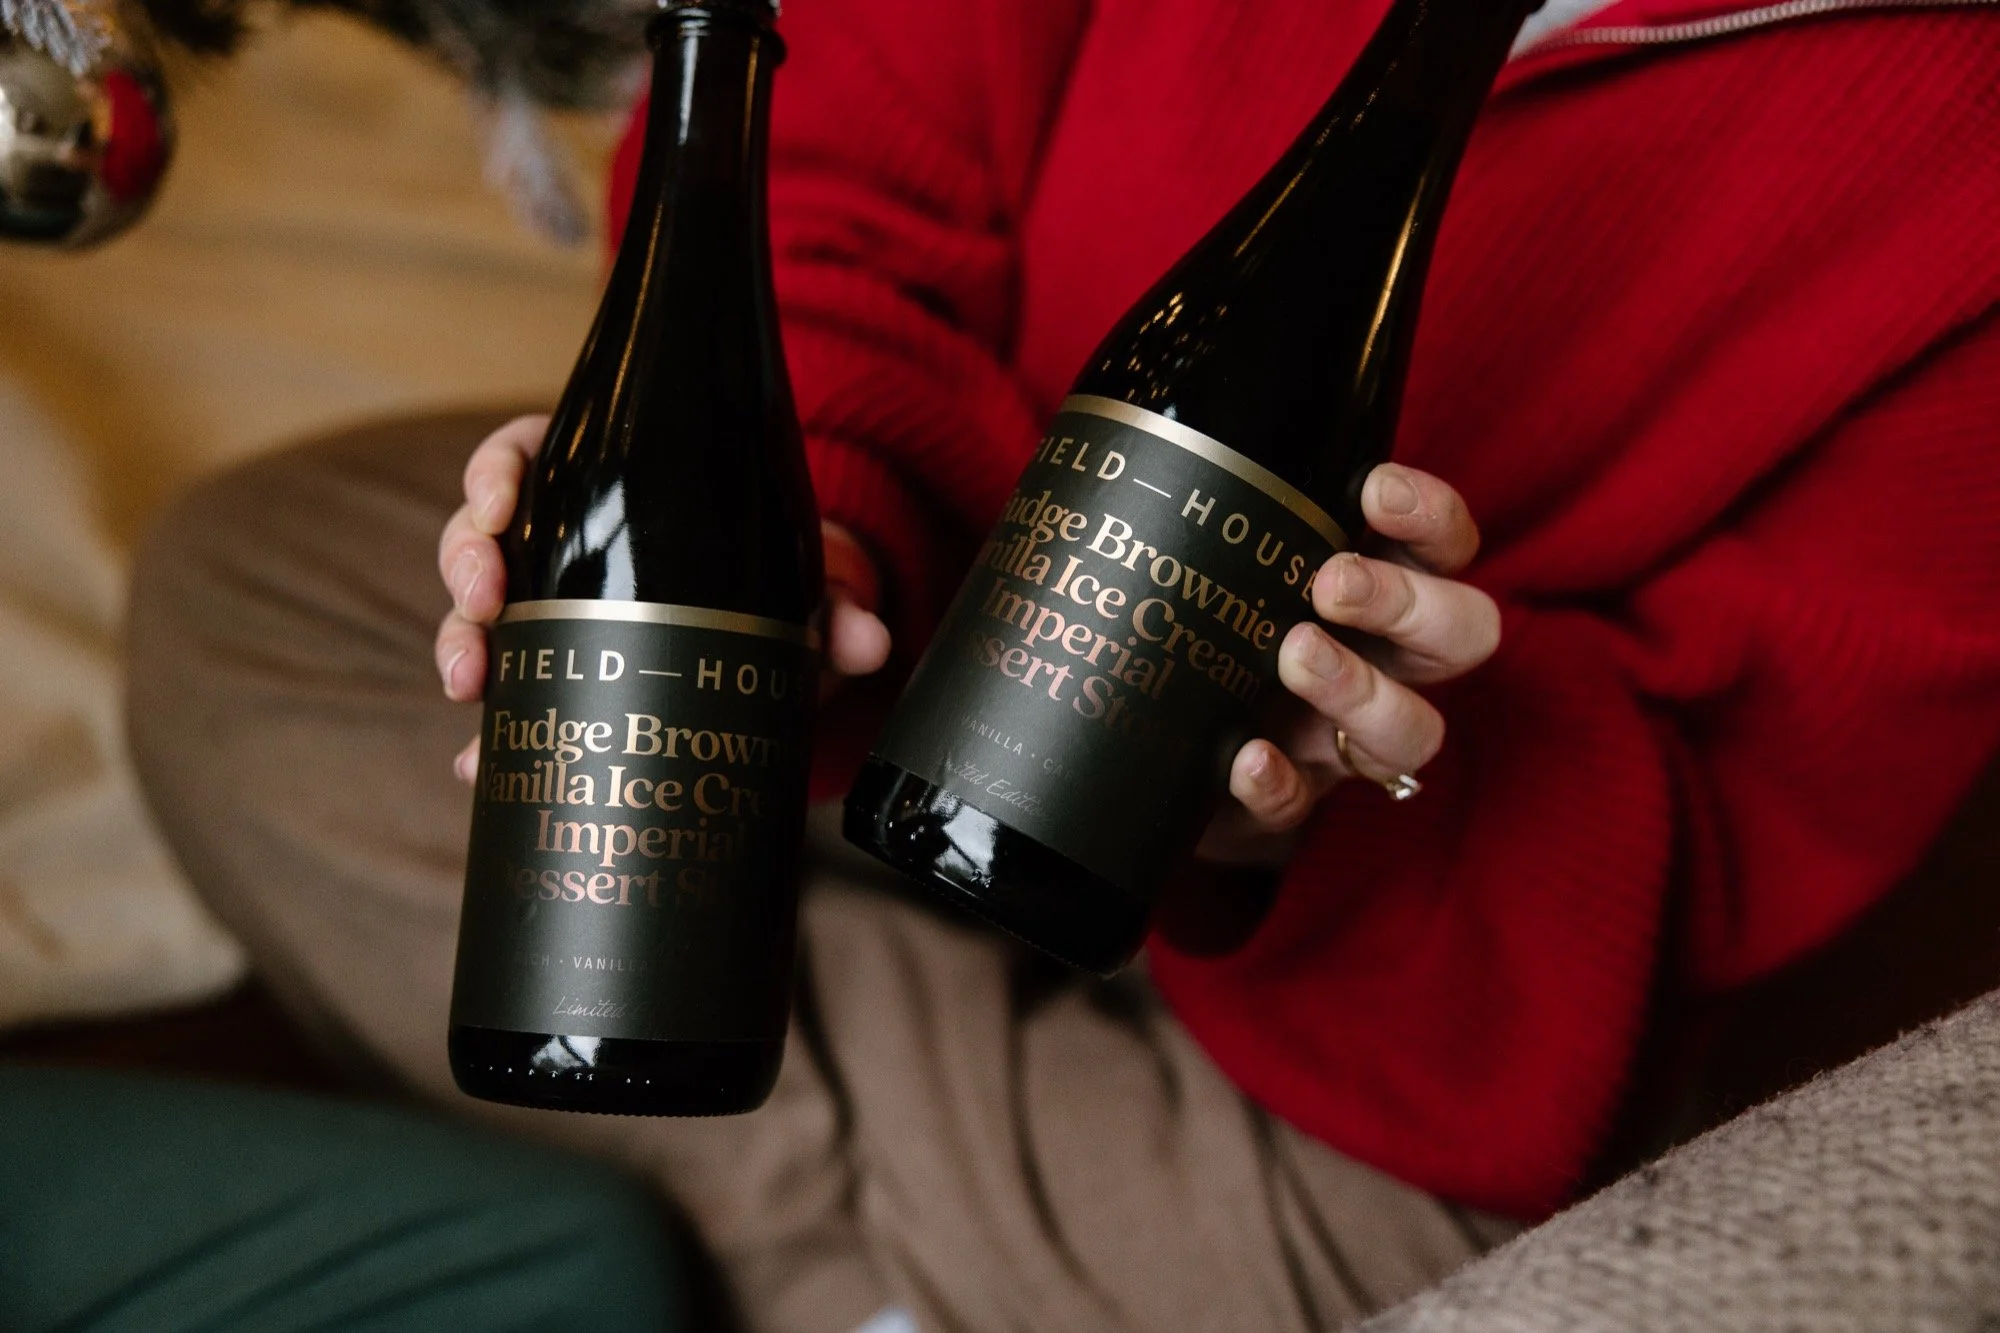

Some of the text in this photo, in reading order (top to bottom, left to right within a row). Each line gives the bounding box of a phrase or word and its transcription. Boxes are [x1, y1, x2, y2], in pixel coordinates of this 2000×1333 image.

[1086, 513, 1275, 650] Brownie
[982, 577, 1175, 700] Imperial
[1051, 555, 1126, 619] Ice
[1132, 598, 1260, 699] Cream
[500, 649, 787, 700] FIELD HOU
[492, 708, 612, 764] Fudge
[604, 765, 683, 811] Ice
[511, 869, 667, 908] essert
